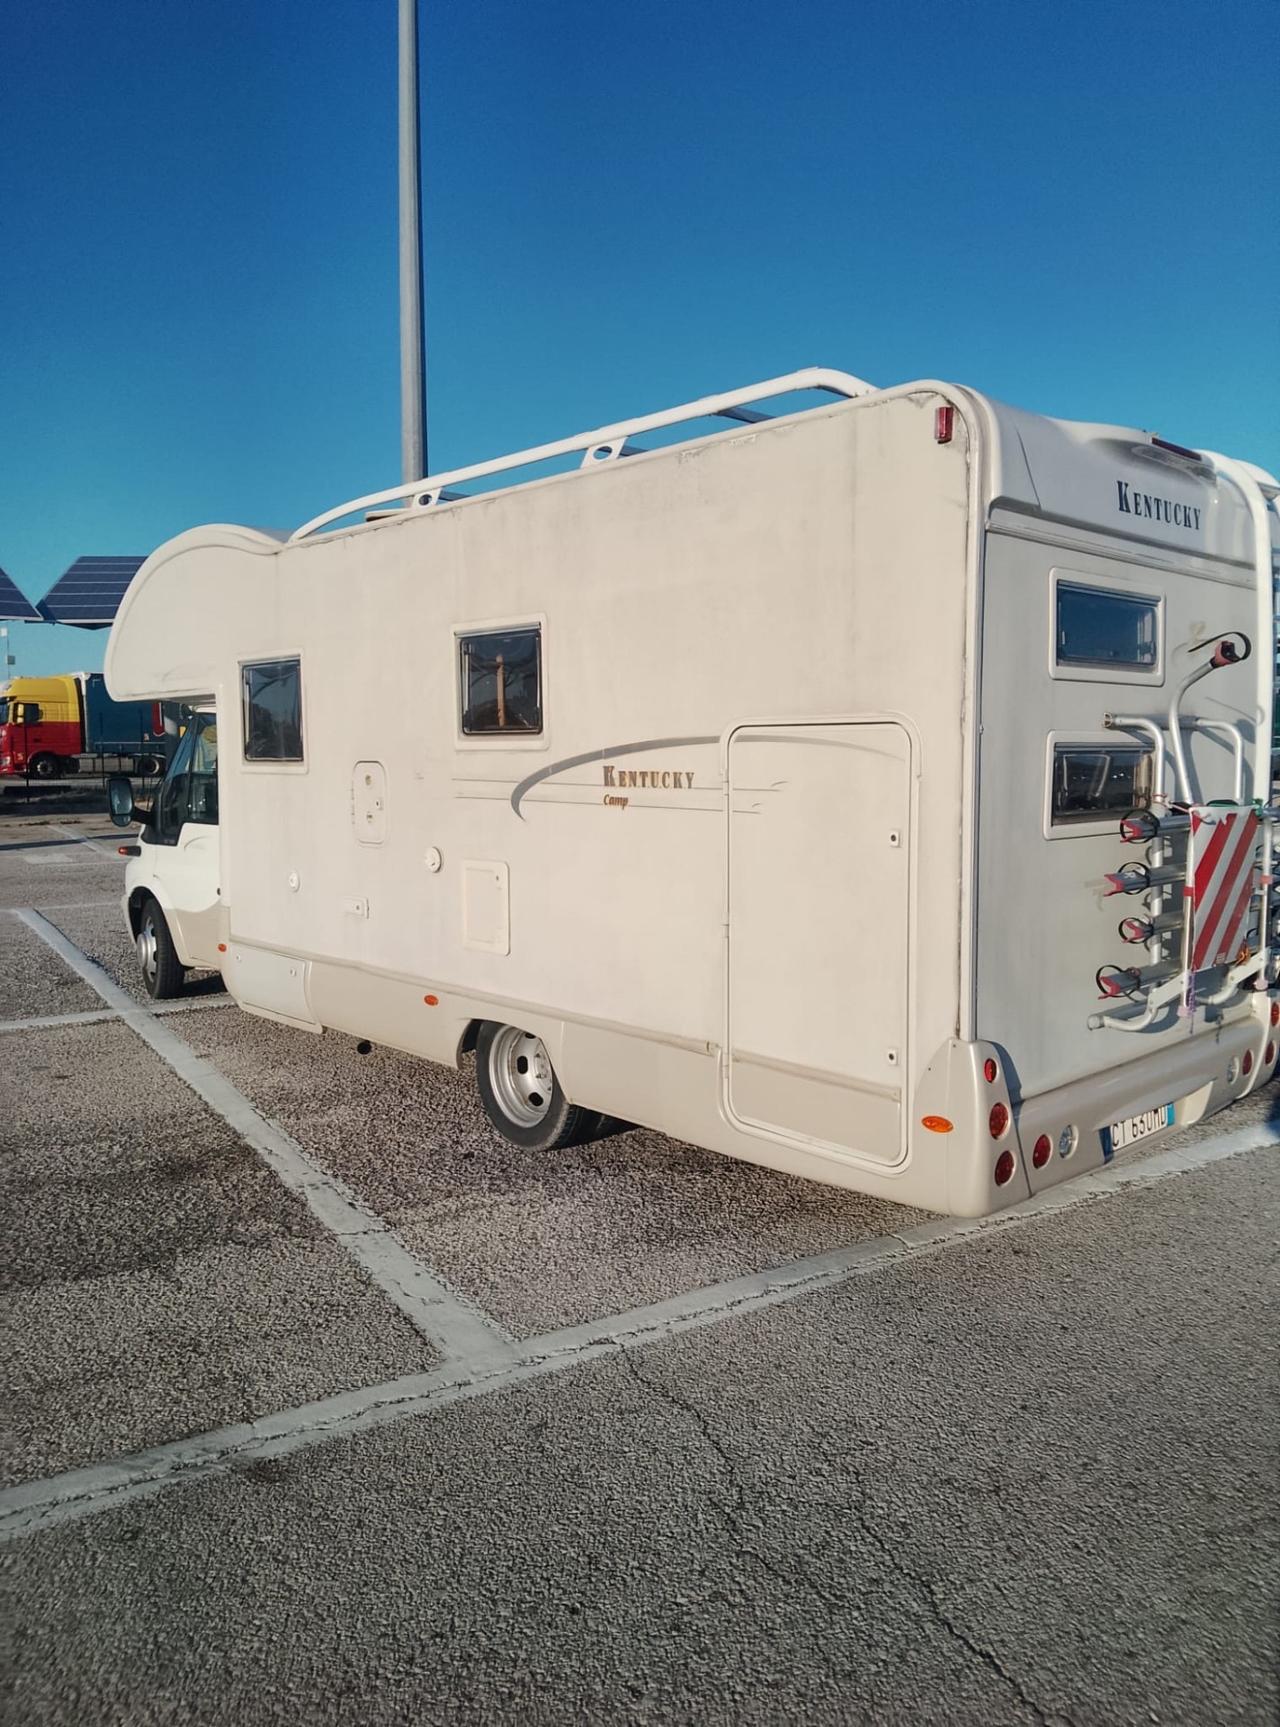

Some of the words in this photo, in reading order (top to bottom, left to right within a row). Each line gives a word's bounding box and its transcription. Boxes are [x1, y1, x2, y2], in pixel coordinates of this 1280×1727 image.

[1117, 480, 1200, 530] KENTUCKY
[603, 765, 694, 789] KENTUCKY
[603, 794, 629, 810] Camp
